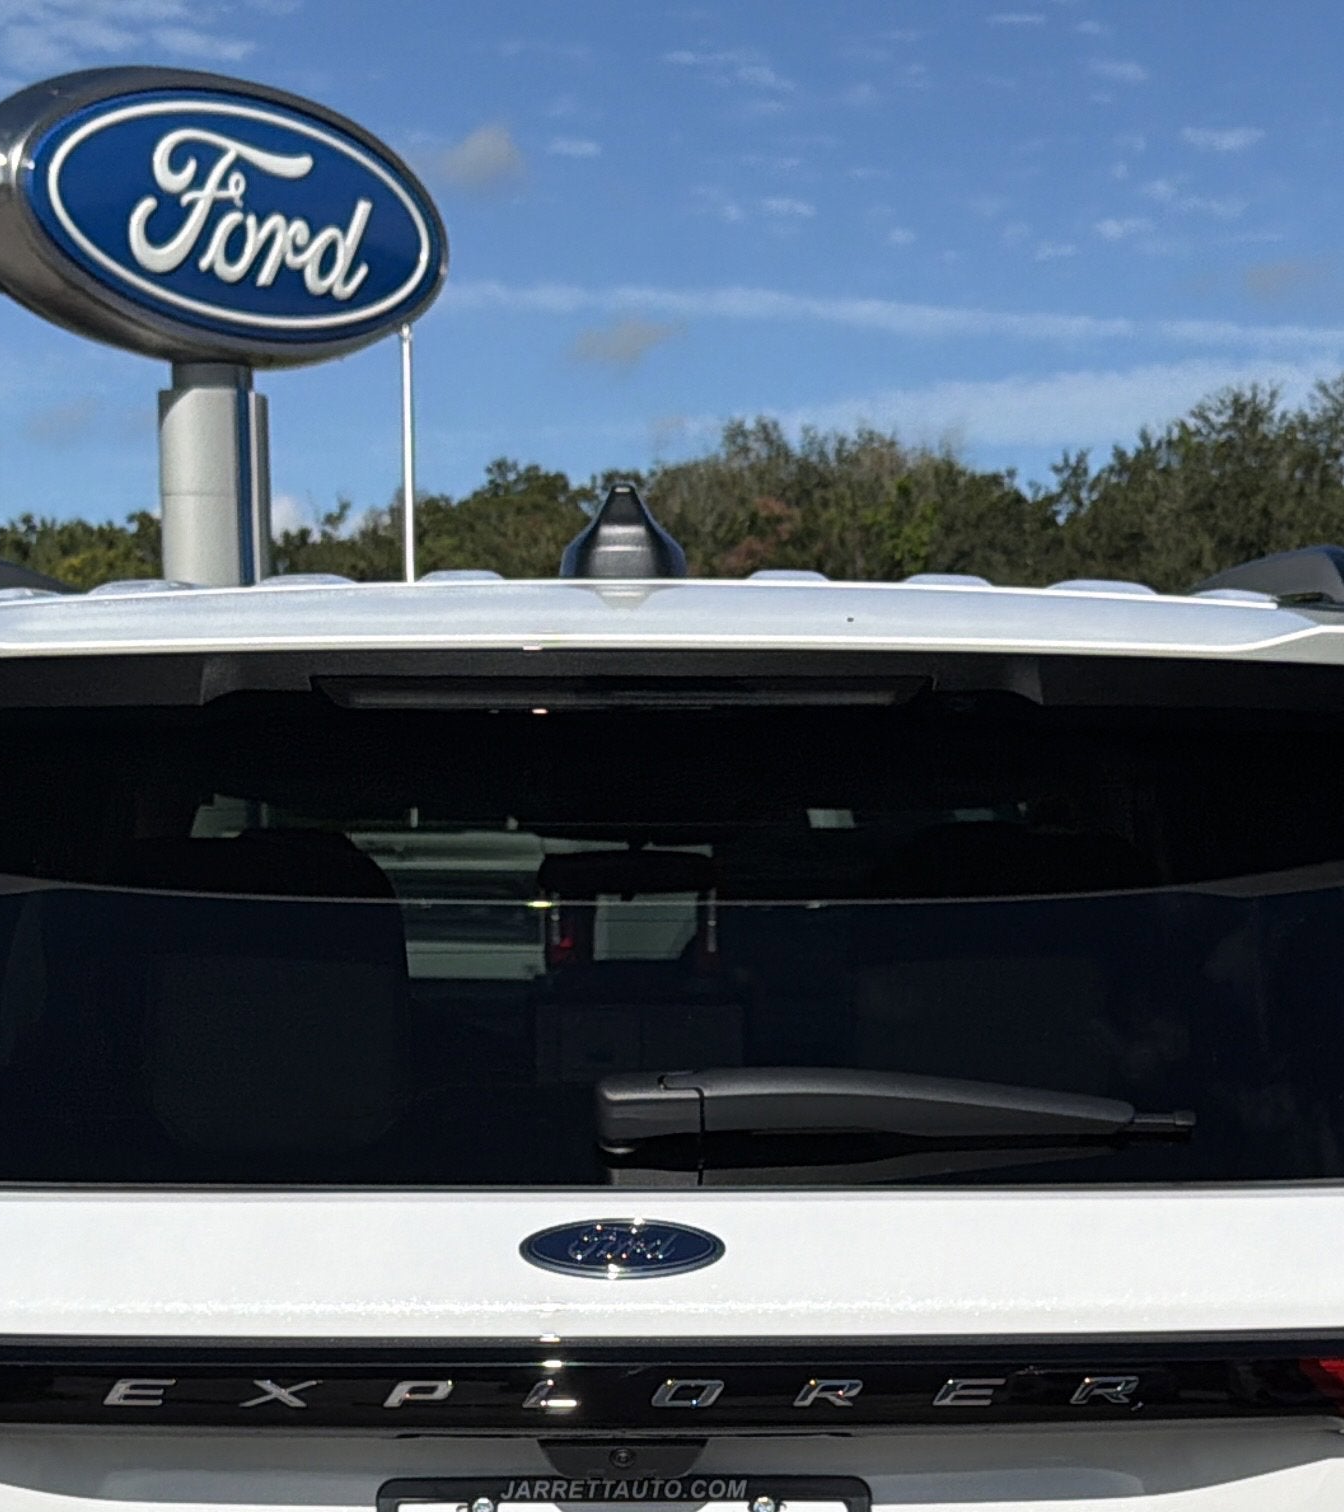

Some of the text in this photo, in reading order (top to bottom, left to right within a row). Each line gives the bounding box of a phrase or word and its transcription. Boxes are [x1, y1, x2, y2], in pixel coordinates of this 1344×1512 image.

[128, 128, 372, 301] Ford
[568, 1222, 680, 1261] Ford
[103, 1377, 1140, 1408] EXPLORER
[500, 1478, 748, 1501] JARRETTAUTO.COM
